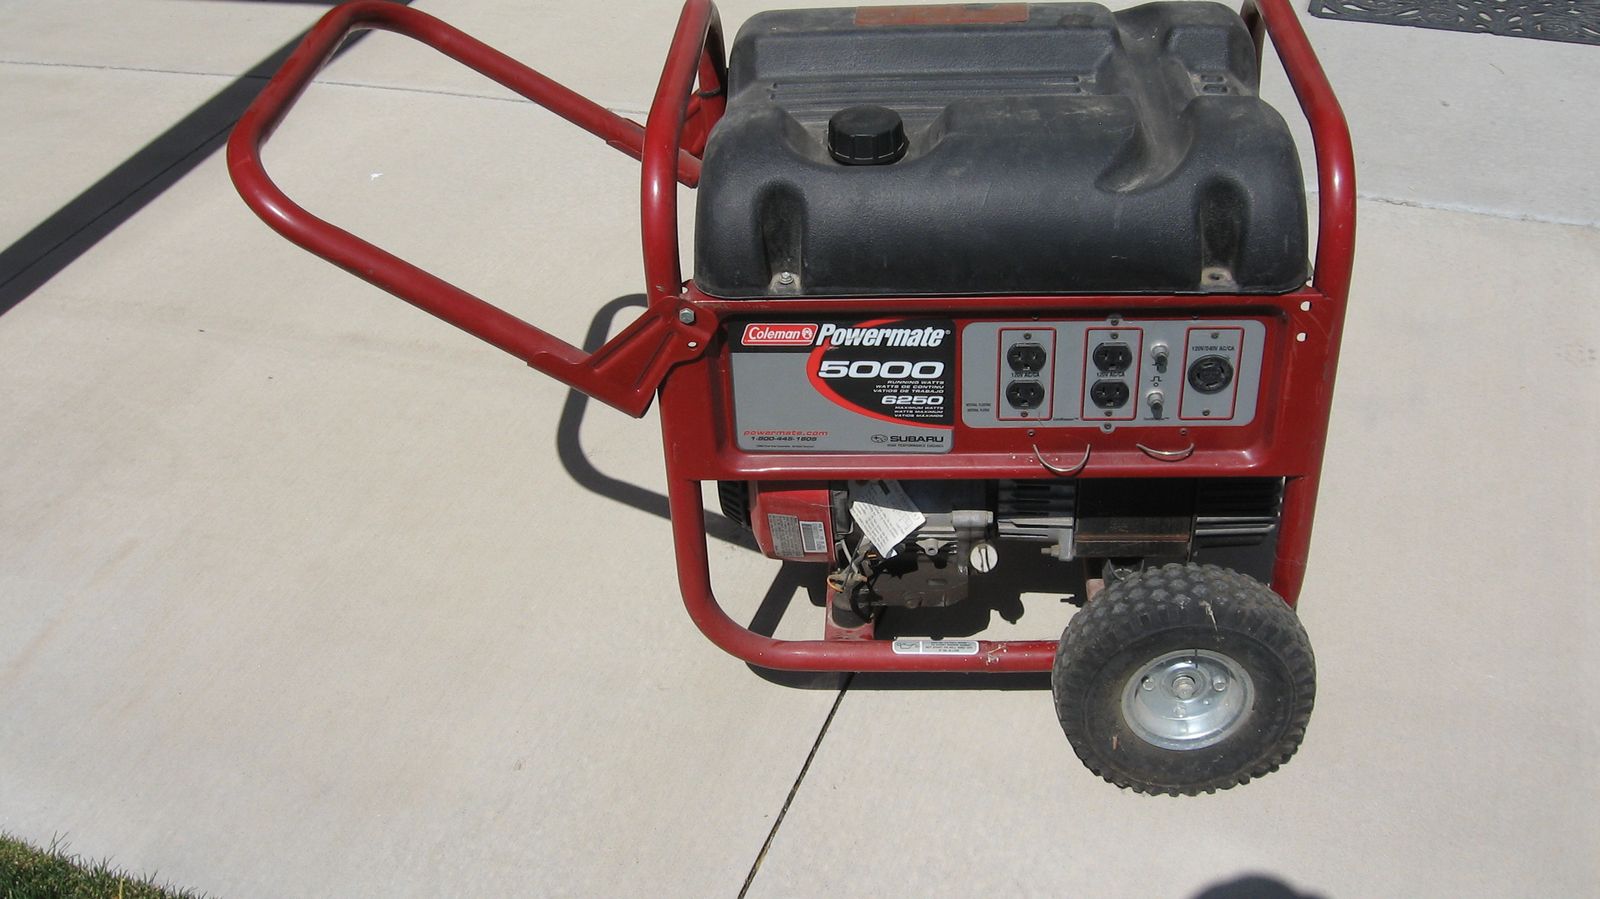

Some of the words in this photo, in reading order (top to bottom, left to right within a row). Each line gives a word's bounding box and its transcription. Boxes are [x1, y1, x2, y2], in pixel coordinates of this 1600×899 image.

[749, 326, 801, 341] Coleman
[816, 323, 945, 347] Powermate
[818, 361, 945, 379] 5000
[881, 396, 944, 405] 6250
